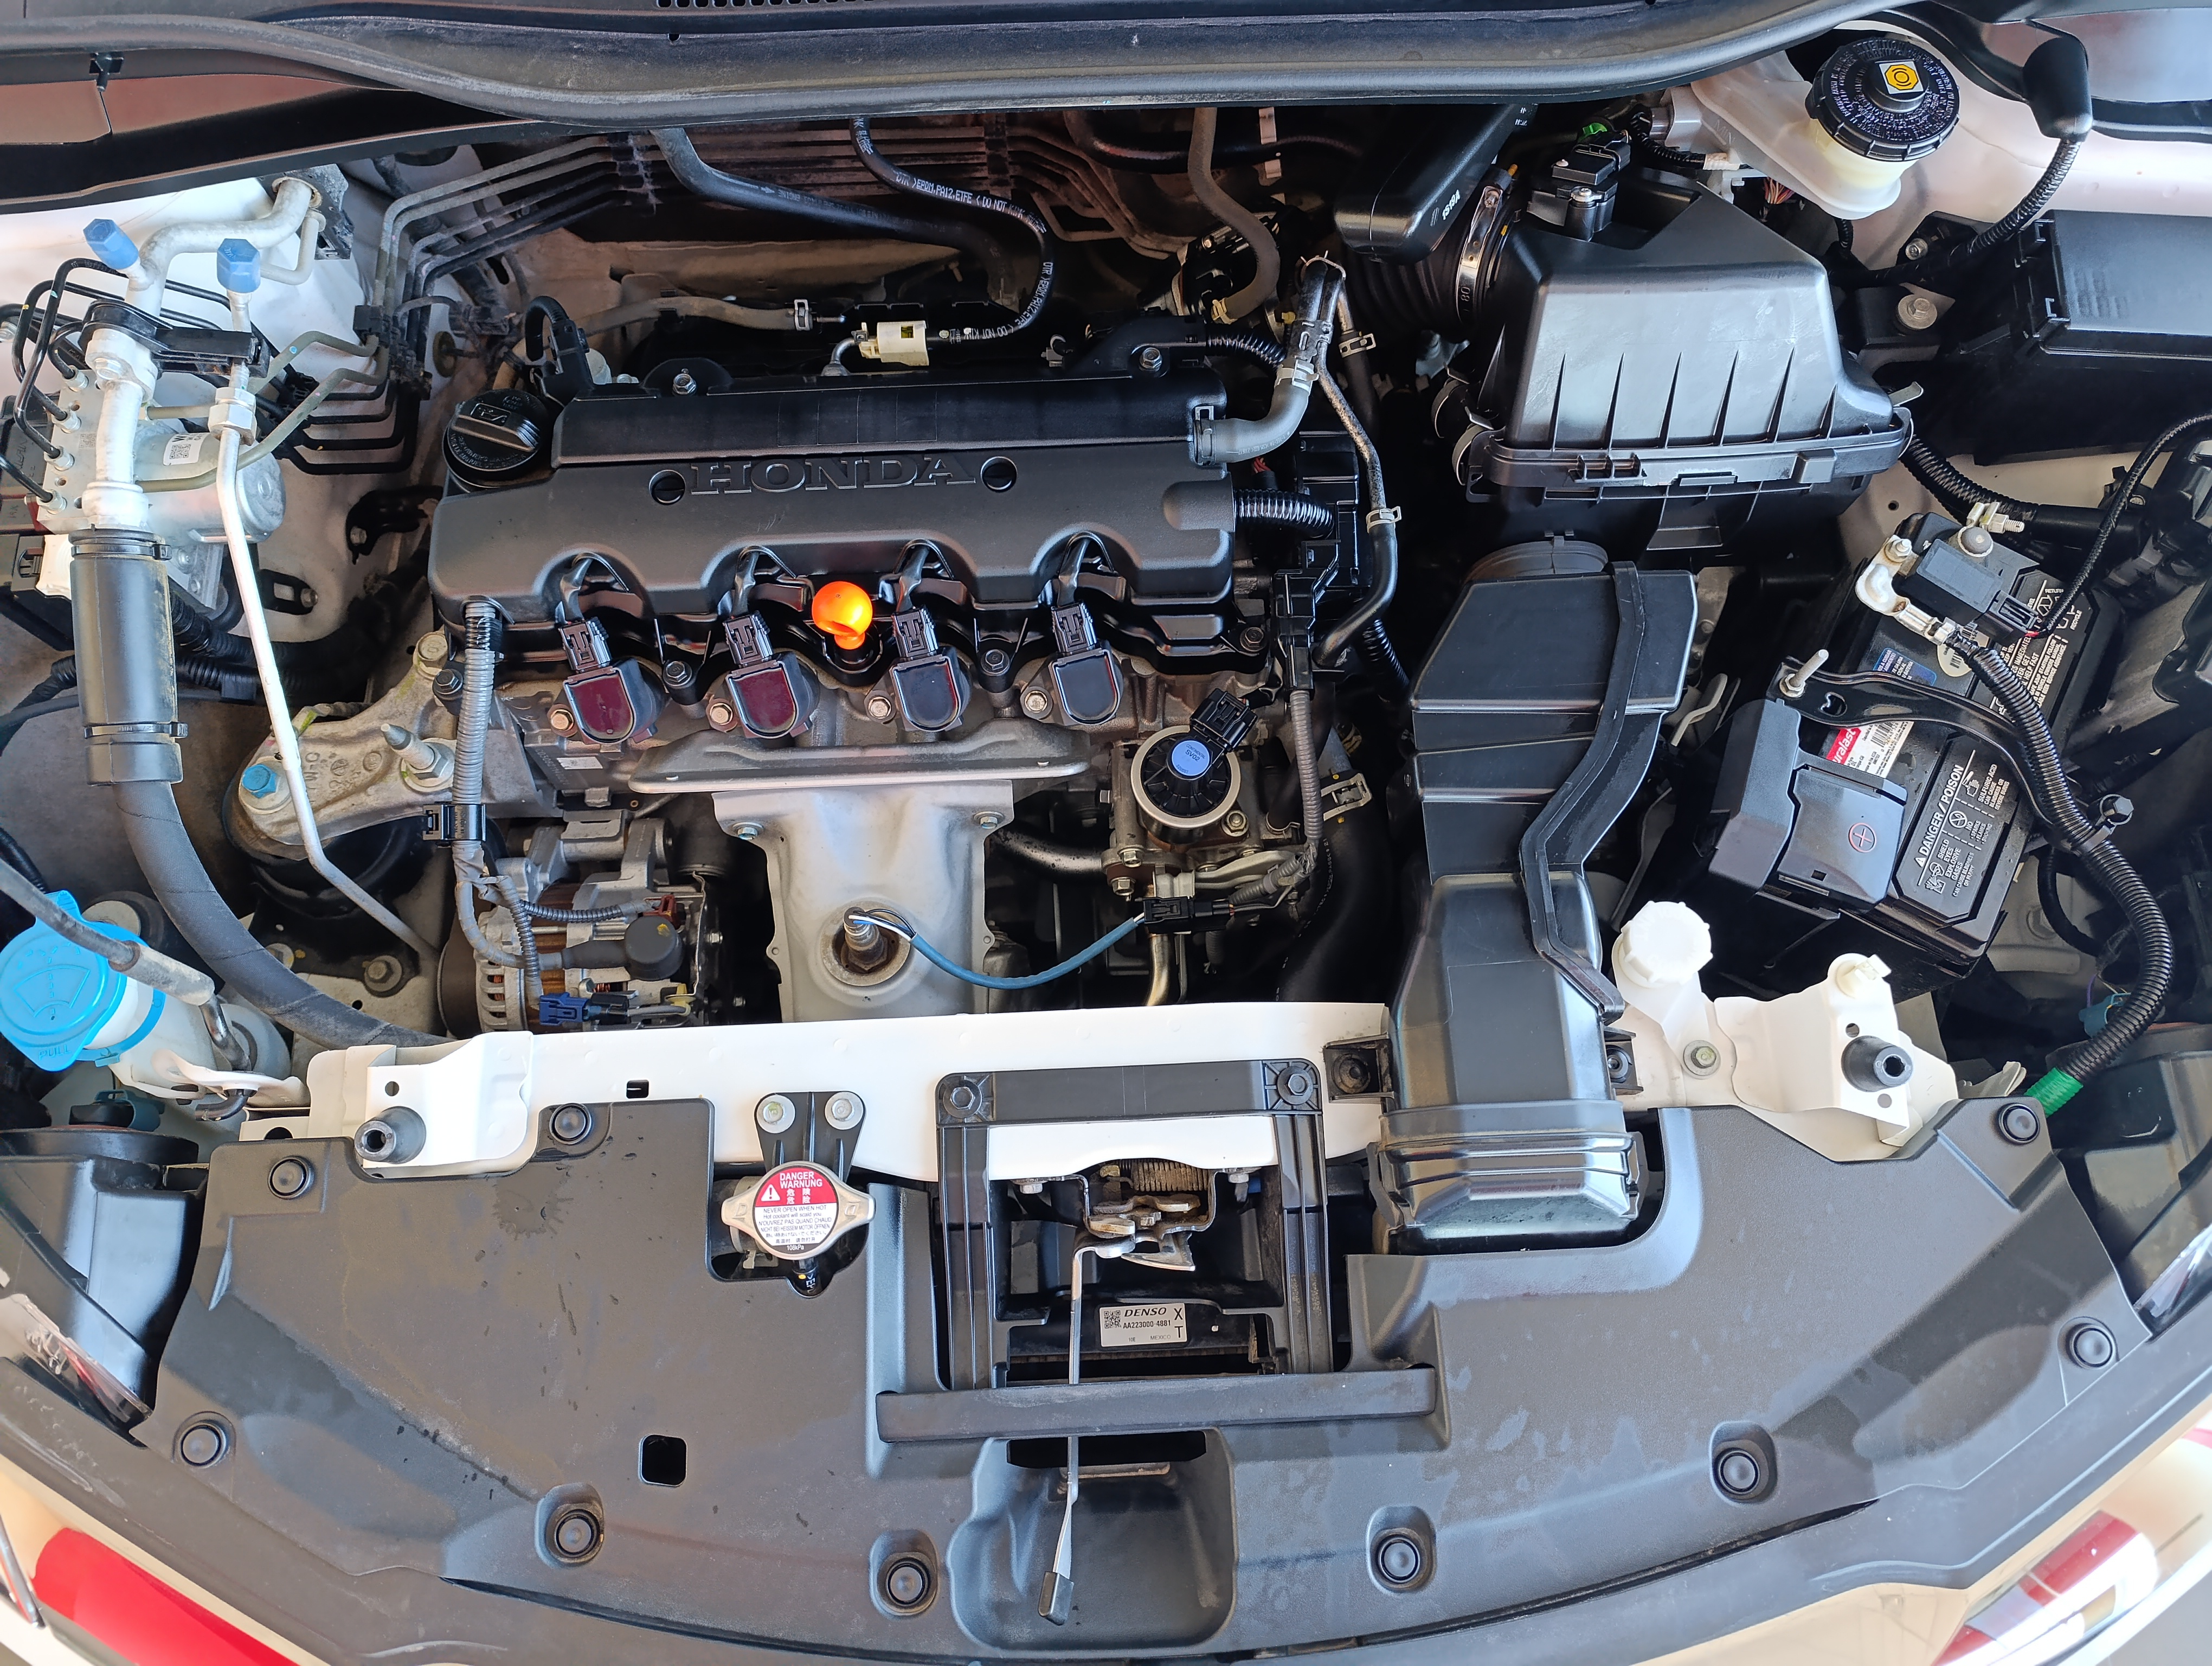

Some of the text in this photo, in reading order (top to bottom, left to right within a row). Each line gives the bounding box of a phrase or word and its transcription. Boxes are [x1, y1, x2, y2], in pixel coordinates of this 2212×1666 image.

[981, 196, 992, 208] DO
[993, 199, 1007, 212] NOT
[691, 453, 975, 494] HONDA
[2069, 609, 2082, 630] RECYCLE
[2013, 635, 2031, 665] IMMEDIATEL
[2046, 639, 2057, 655] FOLLOW
[1882, 649, 1892, 663] CUIDAR
[2021, 655, 2030, 666] GET
[2037, 654, 2050, 674] STARTING
[1902, 659, 1914, 675] BATERÍA
[2023, 665, 2034, 680] HELP
[2029, 652, 2040, 666] FAST
[2033, 673, 2042, 685] JUMP
[2036, 675, 2047, 691] VEHICLE
[2043, 658, 2055, 676] OWNERS
[2042, 683, 2050, 694] SEEK
[2046, 667, 2057, 684] SERVICE
[1185, 743, 1207, 759] CONTINENTAL
[1830, 727, 1856, 764] uralast
[1184, 749, 1200, 761] SV02
[1977, 763, 1998, 802] SULFURIC ACID
[1987, 781, 1997, 795] CAUSE
[1988, 785, 2002, 808] BLINDNESS
[1994, 780, 2010, 810] SEVERE BURNS
[1918, 811, 1944, 856] DANGER
[1940, 764, 1964, 804] POISON
[1964, 820, 1973, 830] NO
[1970, 820, 1981, 837] SPARKS
[1975, 823, 1986, 839] FLAMES
[1980, 823, 1992, 842] SMOKING
[1937, 838, 1950, 859] SHIELD
[1943, 847, 1954, 862] EYES
[1944, 847, 1962, 877] EXPLOSIVE
[1950, 861, 1963, 880] GASES
[1952, 851, 1975, 896] CAN CAUSE BLINDNESS
[1965, 864, 1976, 880] INJURY
[38, 1044, 71, 1060] PULL
[780, 1171, 814, 1181] DANGER
[780, 1178, 822, 1188] WARNUNG
[1124, 1307, 1166, 1317] DENSO
[1174, 1308, 1182, 1320] X
[1123, 1320, 1170, 1328] AA223000-4881
[1174, 1326, 1183, 1337] T
